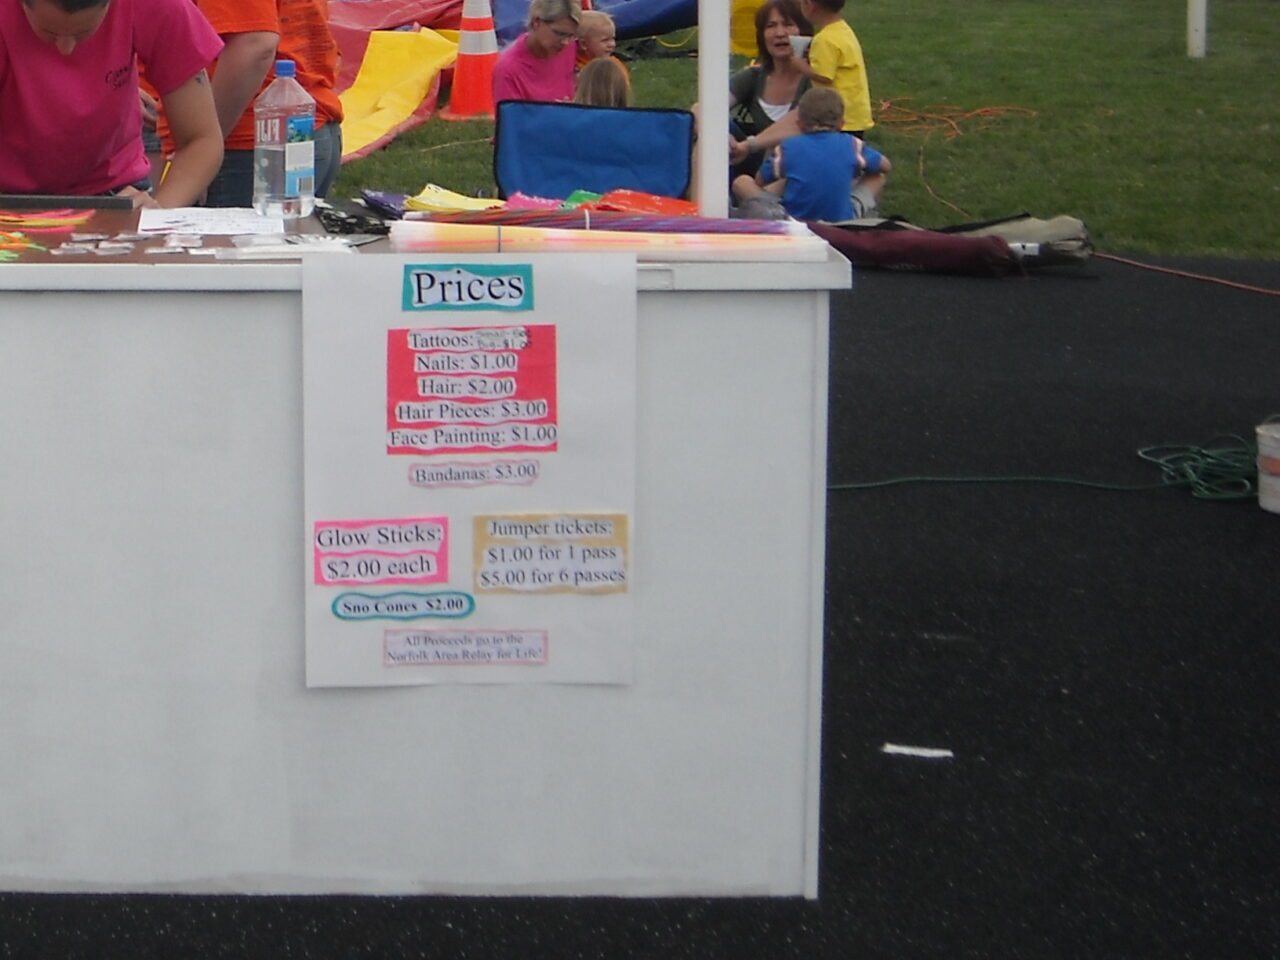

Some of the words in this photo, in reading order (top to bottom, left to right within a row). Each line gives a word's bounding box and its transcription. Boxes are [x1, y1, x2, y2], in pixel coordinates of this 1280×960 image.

[414, 269, 525, 306] Prices
[410, 332, 474, 348] Tattoos:
[417, 355, 465, 371] Nails:
[470, 353, 516, 371] $1.00
[421, 378, 463, 395] Hair:
[468, 377, 514, 395] $2.00
[398, 404, 434, 420] Hair
[439, 403, 495, 419] Pieces:
[501, 401, 547, 418] $3.00
[391, 430, 428, 446] Face
[434, 426, 505, 447] Painting:
[512, 425, 557, 442] $1.00
[415, 467, 491, 483] Bandanas:
[495, 463, 536, 480] $3.00
[317, 528, 370, 548] Glow
[377, 525, 441, 545] Sticks:
[490, 521, 550, 540] Jumper
[555, 519, 613, 535] tickets:
[488, 545, 534, 564] $1.00
[539, 545, 562, 561] for
[569, 545, 574, 560] 1
[581, 548, 617, 564] pass
[327, 558, 381, 580] $2.00
[387, 555, 431, 575] each
[480, 569, 526, 588] $5.00
[531, 568, 554, 584] for
[559, 567, 569, 582] 6
[574, 570, 626, 586] passes
[342, 601, 370, 614] Sno
[374, 601, 418, 614] Cones
[425, 598, 464, 611] $2.00
[387, 650, 429, 663] Norfolk
[433, 649, 459, 661] Area
[462, 649, 492, 663] Relay
[497, 648, 512, 659] for
